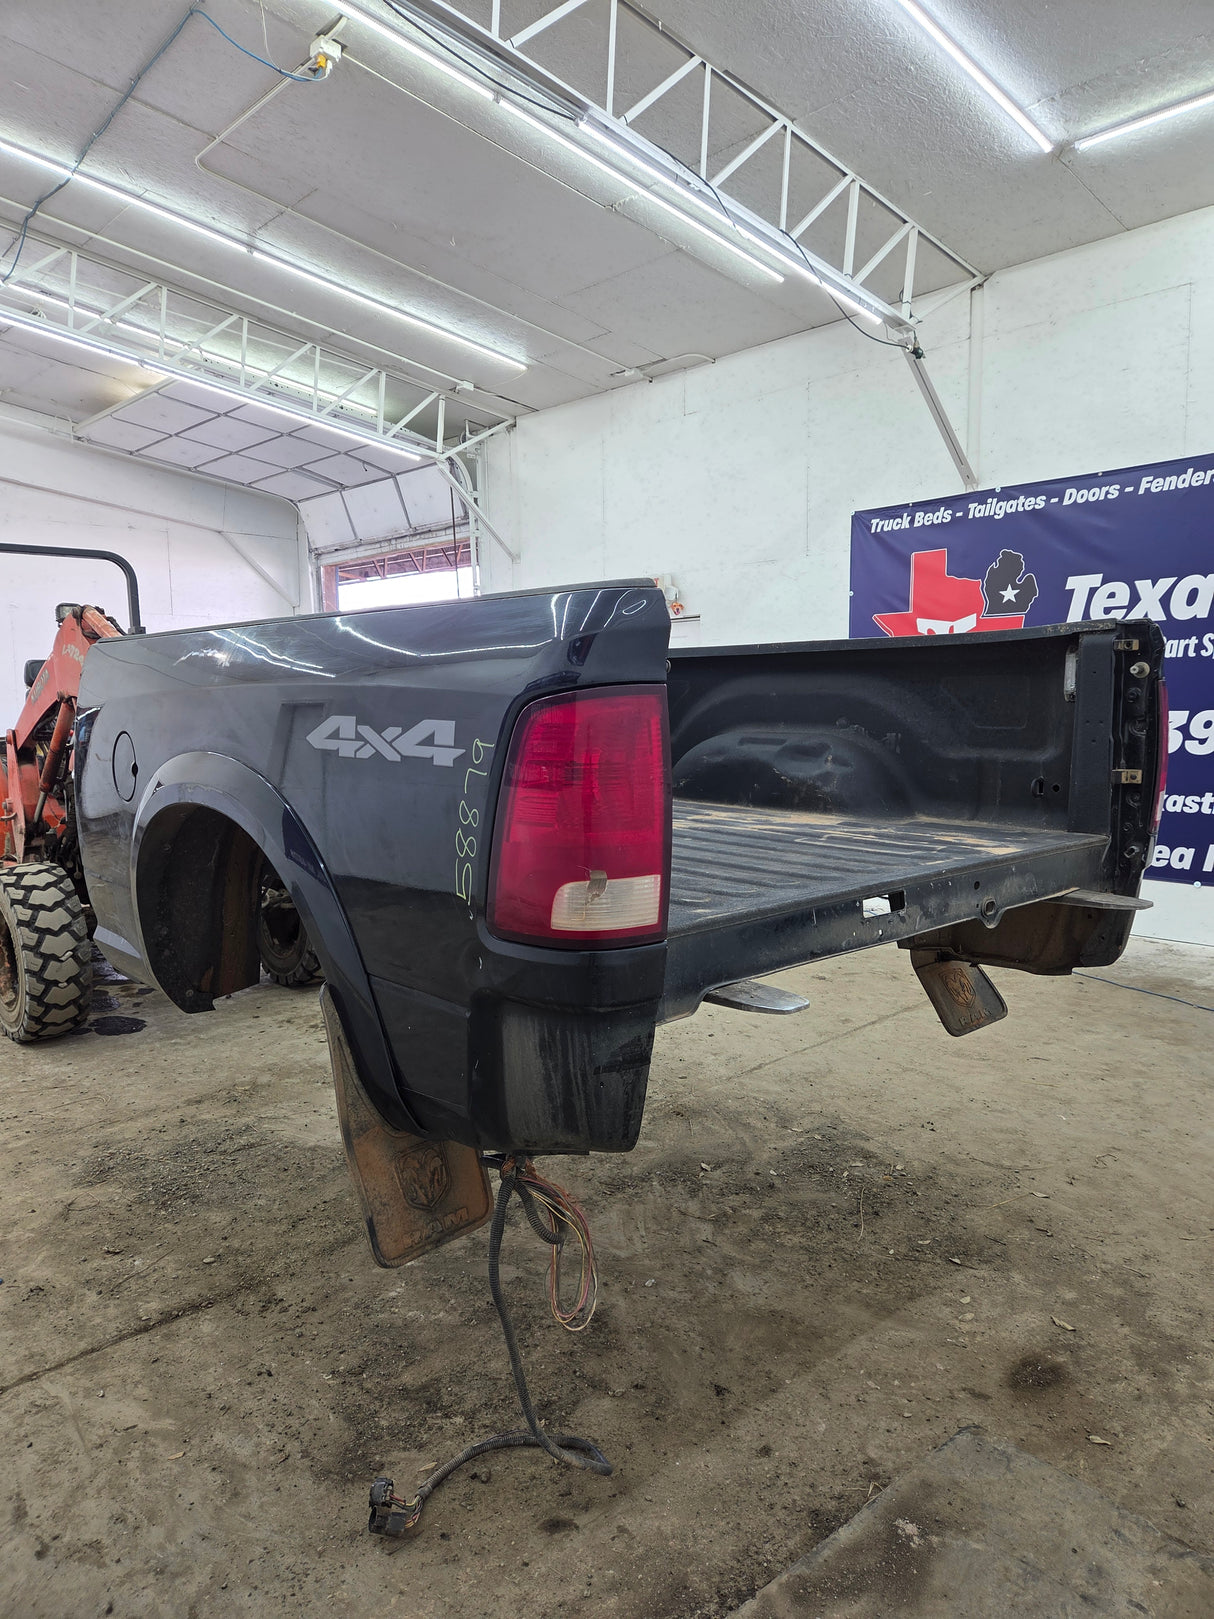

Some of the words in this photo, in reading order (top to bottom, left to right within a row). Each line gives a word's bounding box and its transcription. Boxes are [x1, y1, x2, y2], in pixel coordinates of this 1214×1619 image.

[870, 513, 912, 533] Truck
[913, 507, 953, 527] Beds
[967, 495, 1047, 519] Tailgates
[1062, 484, 1121, 506] Doors
[1138, 468, 1214, 495] Fender
[1163, 636, 1199, 658] art
[454, 738, 495, 906] 58879
[1161, 792, 1214, 815] ast
